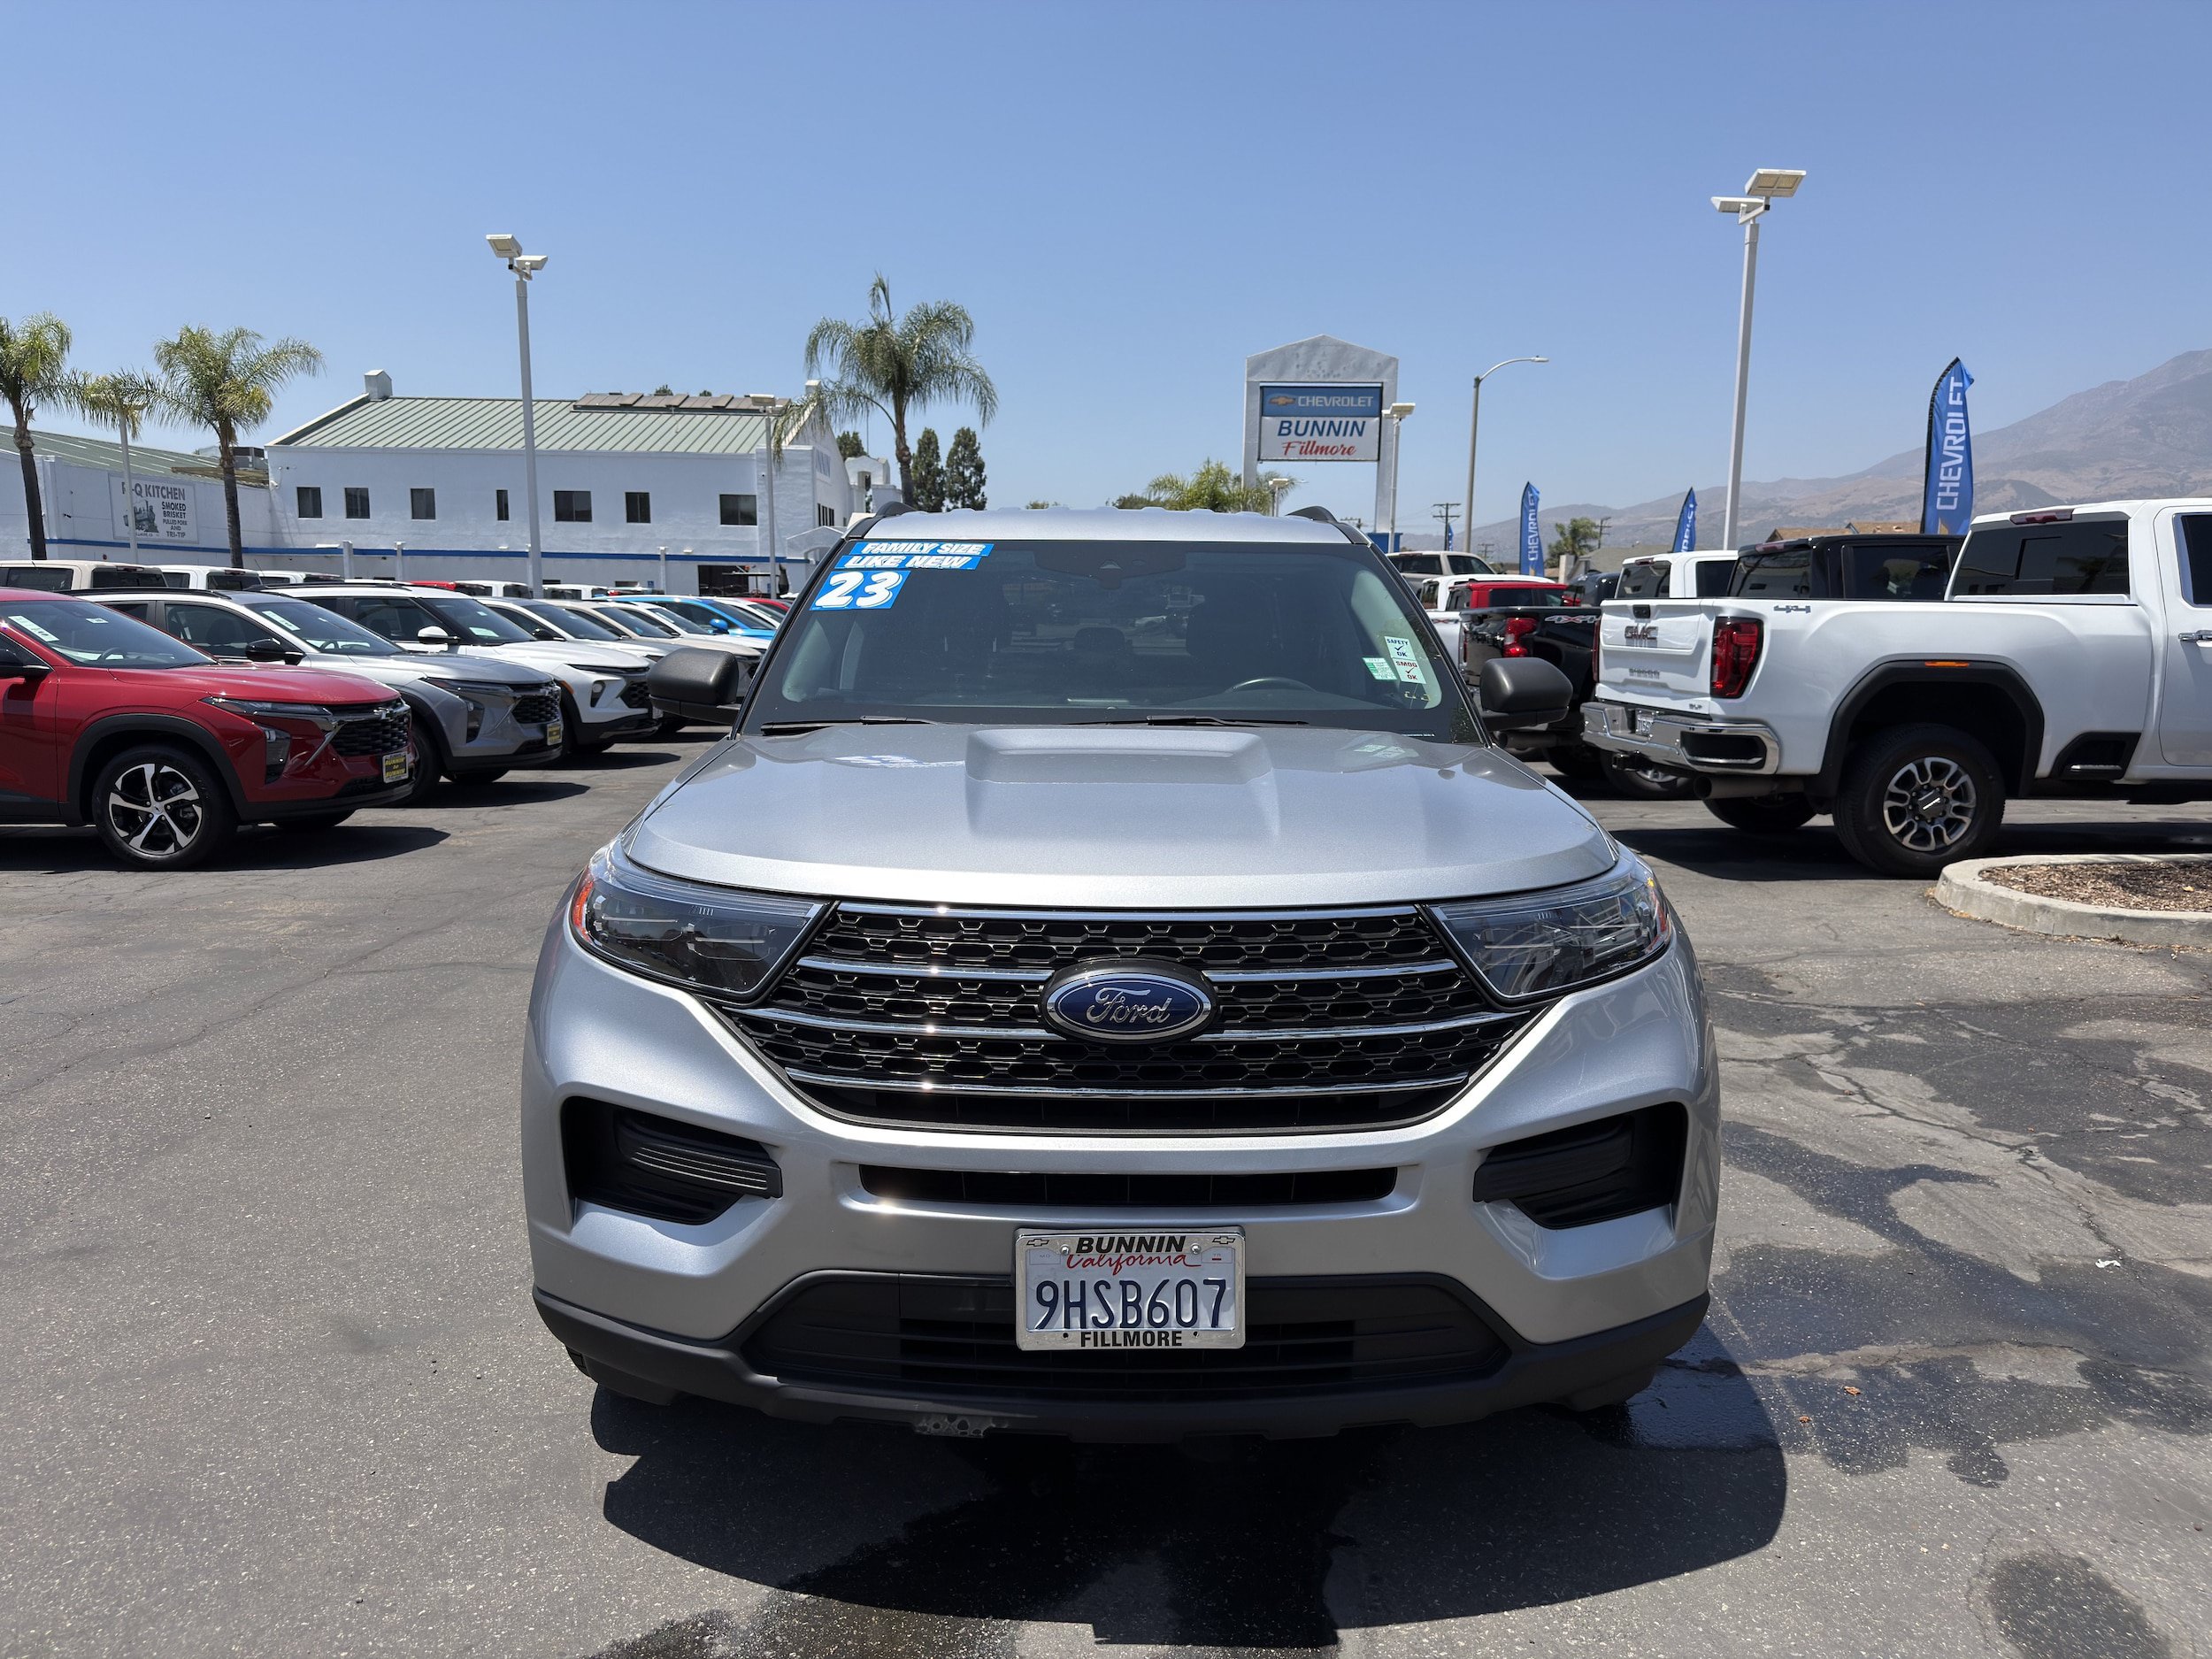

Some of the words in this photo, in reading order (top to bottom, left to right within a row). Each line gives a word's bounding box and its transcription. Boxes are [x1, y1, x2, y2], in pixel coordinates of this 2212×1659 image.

[1298, 396, 1374, 407] CHEVROLET
[1277, 420, 1366, 437] BUNNIN
[1282, 441, 1356, 456] Fillmore
[144, 484, 186, 501] KITCHEN
[161, 501, 187, 511] SMOKED
[860, 542, 940, 555] FAMILY
[936, 543, 987, 555] SIZE
[843, 556, 907, 568] LIKE
[904, 556, 972, 569] NEW
[814, 571, 903, 609] 23
[1624, 626, 1659, 640] GMC
[1086, 987, 1172, 1024] Ford
[1075, 1235, 1187, 1254] BUNNIN
[1066, 1254, 1202, 1275] California
[1034, 1279, 1226, 1330] 9HSB607
[1080, 1331, 1182, 1348] FILLMORE
